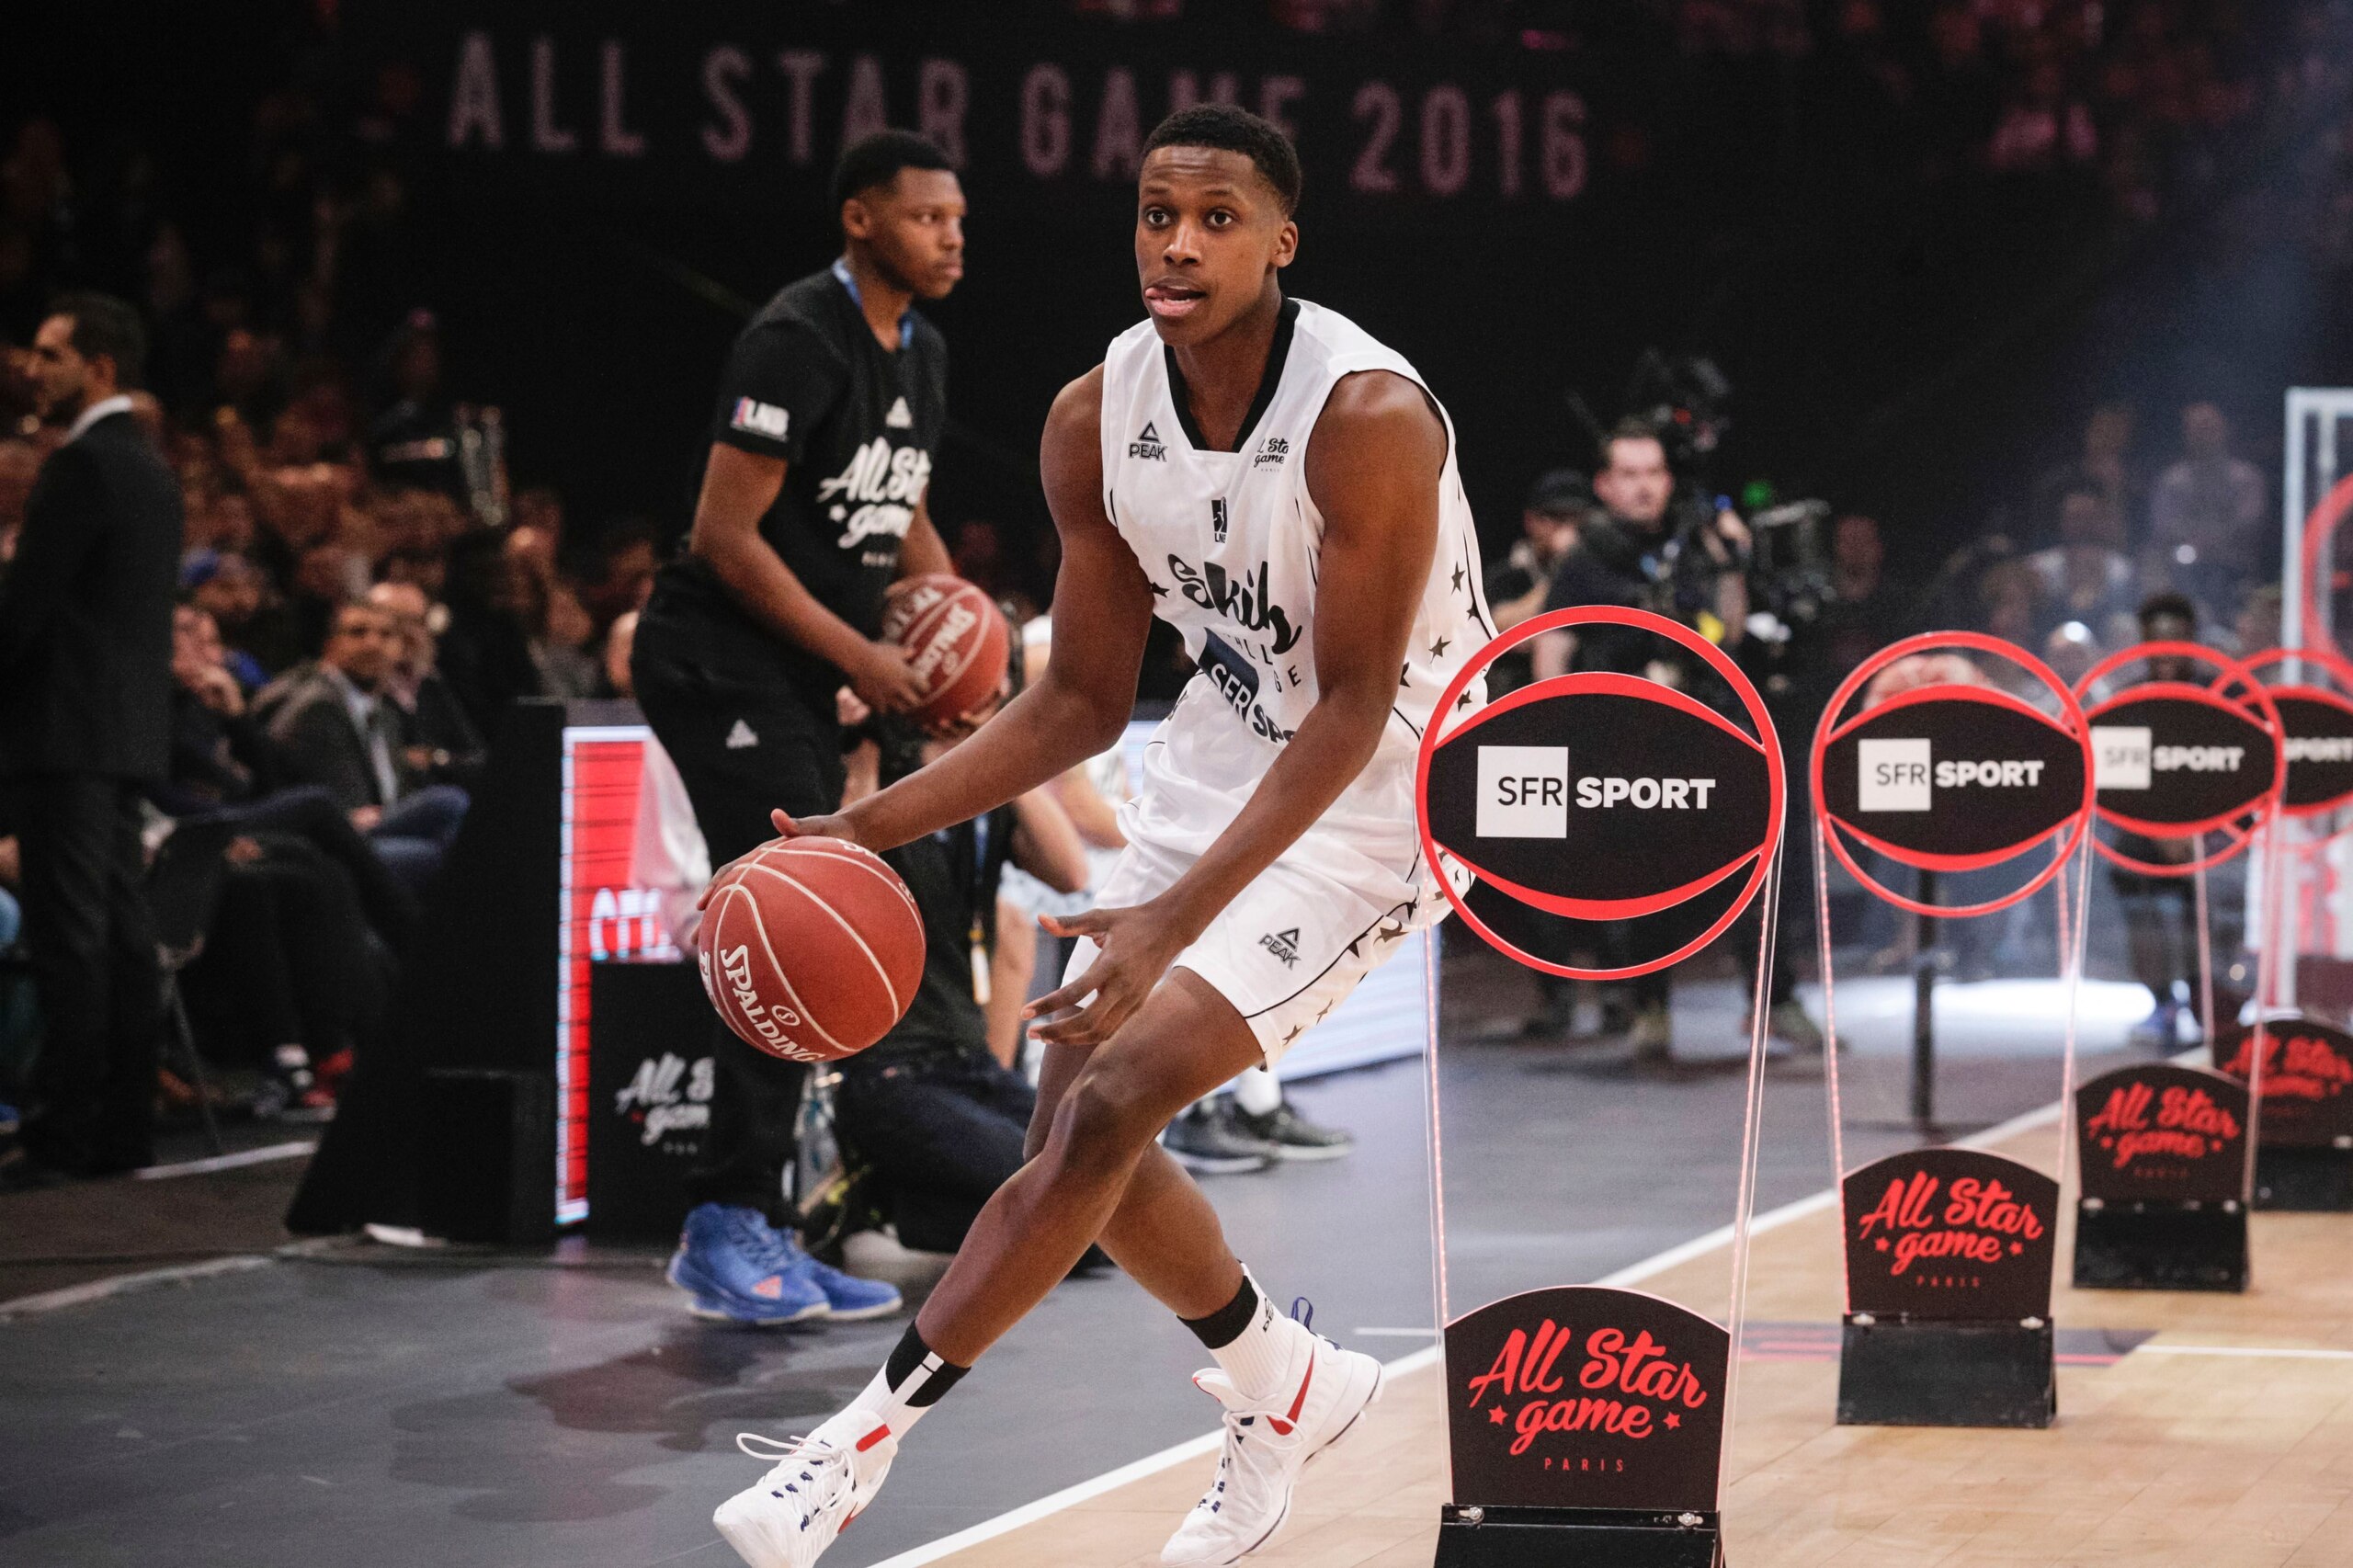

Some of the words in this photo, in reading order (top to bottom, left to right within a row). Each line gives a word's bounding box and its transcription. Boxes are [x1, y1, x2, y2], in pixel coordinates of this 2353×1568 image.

[449, 30, 645, 154] ALL
[701, 44, 971, 171] STAR
[1348, 80, 1588, 199] 2016
[1129, 443, 1168, 462] PEAK
[1253, 454, 1285, 468] game
[1267, 437, 1289, 454] Sta
[1876, 763, 1927, 787] SFR
[1935, 760, 2044, 788] SPORT
[2154, 745, 2245, 771] SPORT
[1497, 777, 1563, 806] SFR
[1575, 777, 1716, 809] SPORT
[1258, 933, 1302, 970] PEAK
[721, 944, 826, 1062] SPALDING
[2087, 1081, 2154, 1140] All
[2157, 1086, 2241, 1140] Star
[1859, 1170, 1939, 1240] All
[1944, 1177, 2044, 1240] Star
[1891, 1232, 2003, 1276] game
[1469, 1318, 1571, 1408] All
[1579, 1327, 1708, 1409] Star
[1509, 1397, 1654, 1456] game
[1544, 1457, 1624, 1471] PARIS
